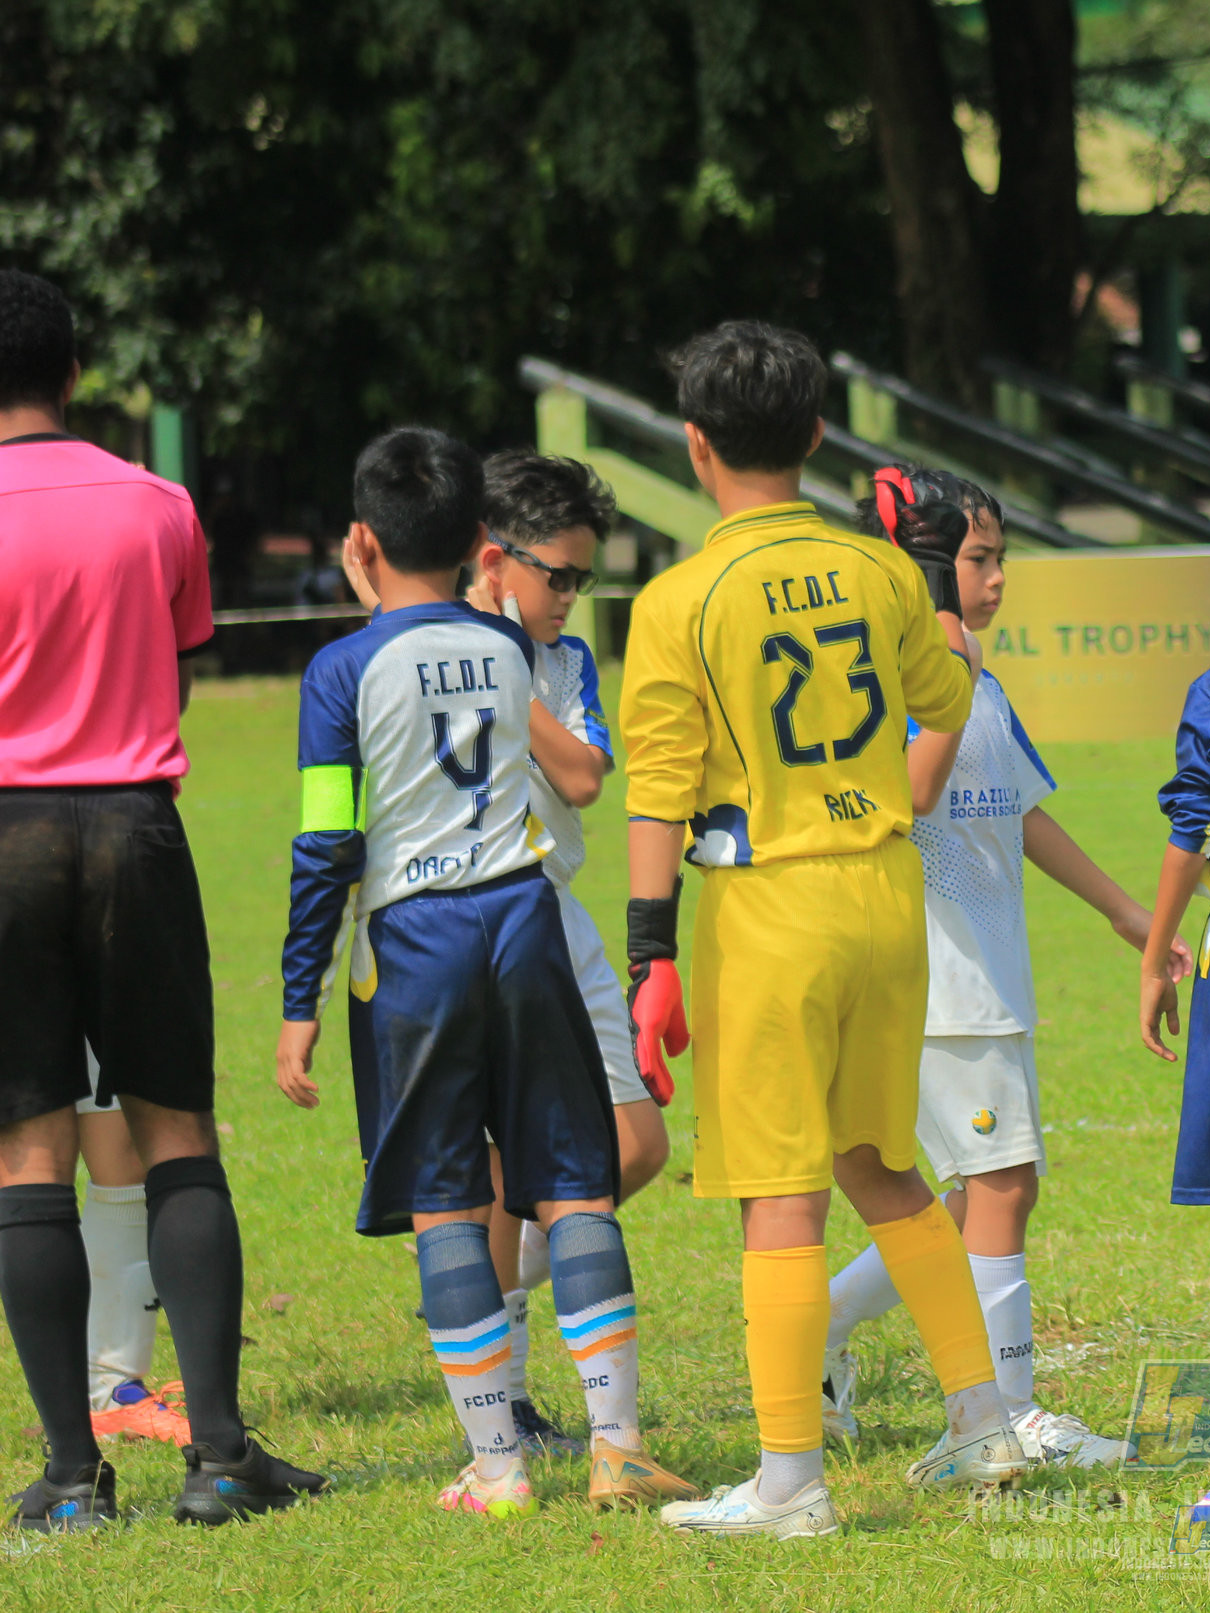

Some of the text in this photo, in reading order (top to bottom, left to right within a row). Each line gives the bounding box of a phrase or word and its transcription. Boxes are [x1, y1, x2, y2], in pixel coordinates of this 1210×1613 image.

[417, 657, 499, 697] F.C.D.C
[761, 618, 887, 767] 23
[431, 707, 496, 831] 4
[950, 806, 997, 819] SOCCER
[464, 1391, 507, 1409] FCDC
